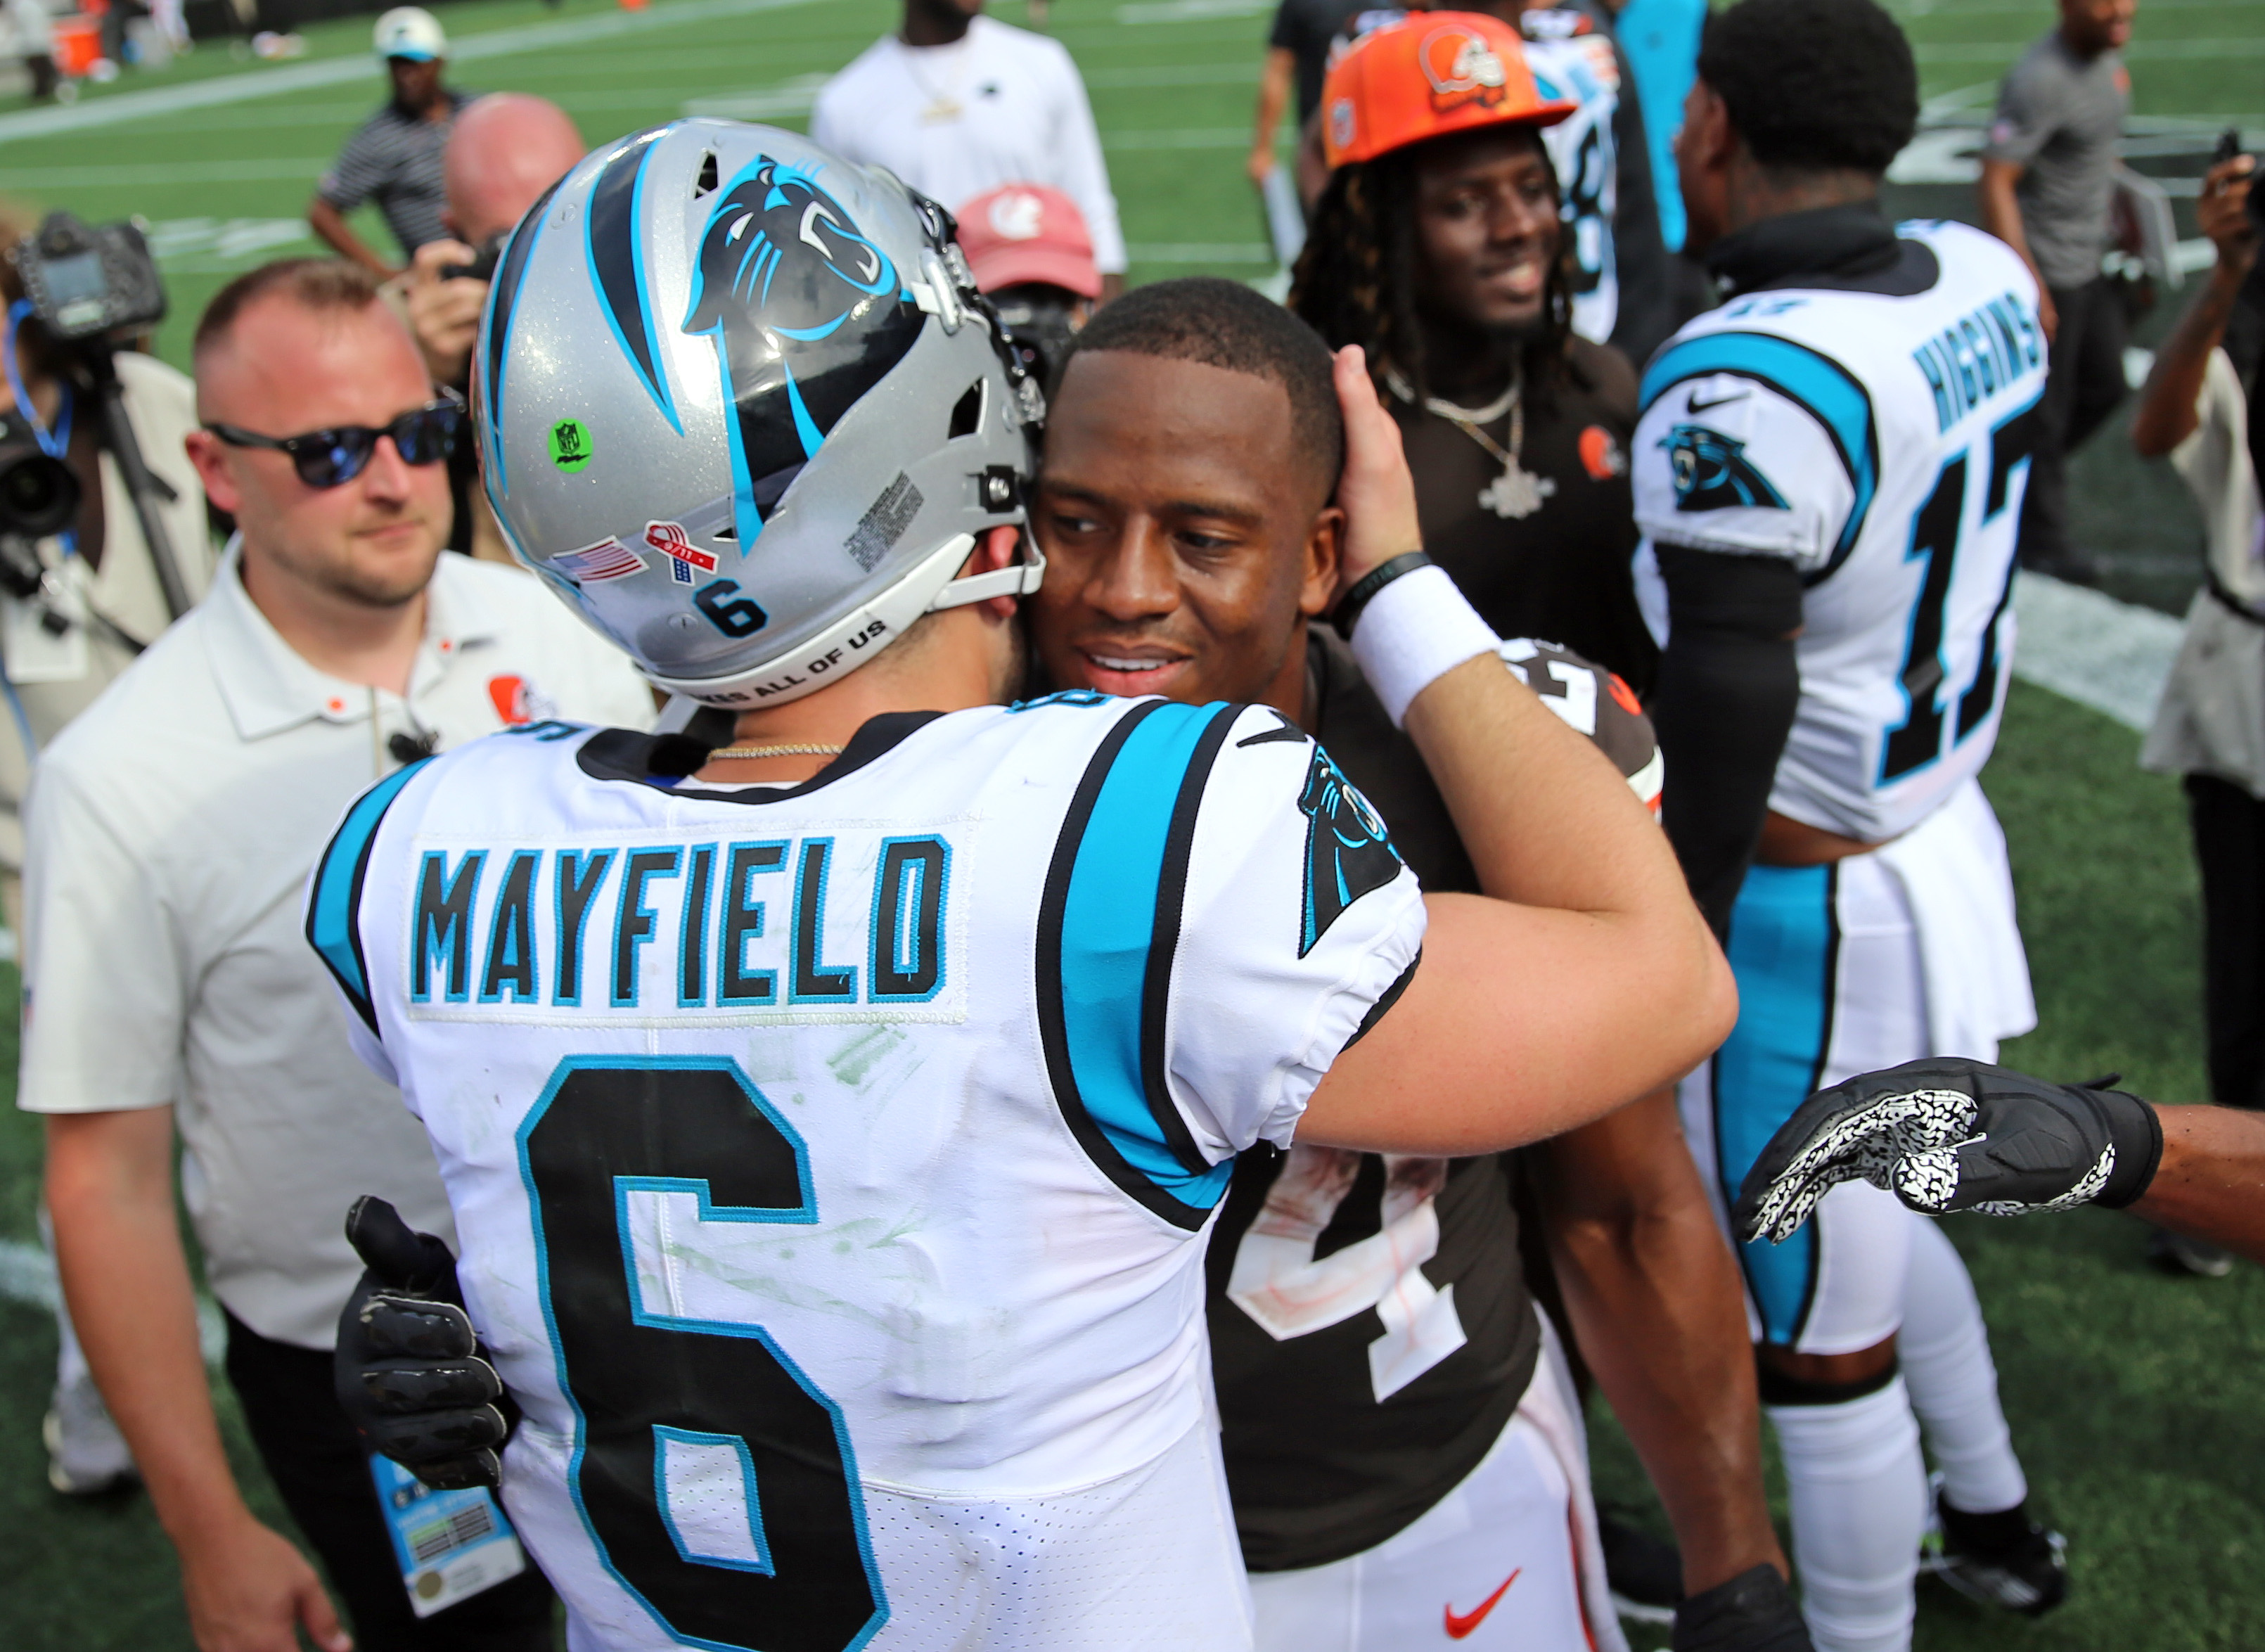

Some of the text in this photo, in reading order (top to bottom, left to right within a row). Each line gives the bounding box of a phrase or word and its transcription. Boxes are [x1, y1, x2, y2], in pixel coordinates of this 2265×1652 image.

[1911, 291, 2039, 435] HIGGINS
[663, 541, 693, 561] 9/11
[691, 577, 769, 639] 6
[1873, 385, 2043, 789] 17
[754, 674, 807, 697] ALL
[808, 648, 843, 674] OF
[847, 620, 887, 650] US
[411, 833, 954, 1008] MAYFIELD
[515, 1054, 890, 1652] 6
